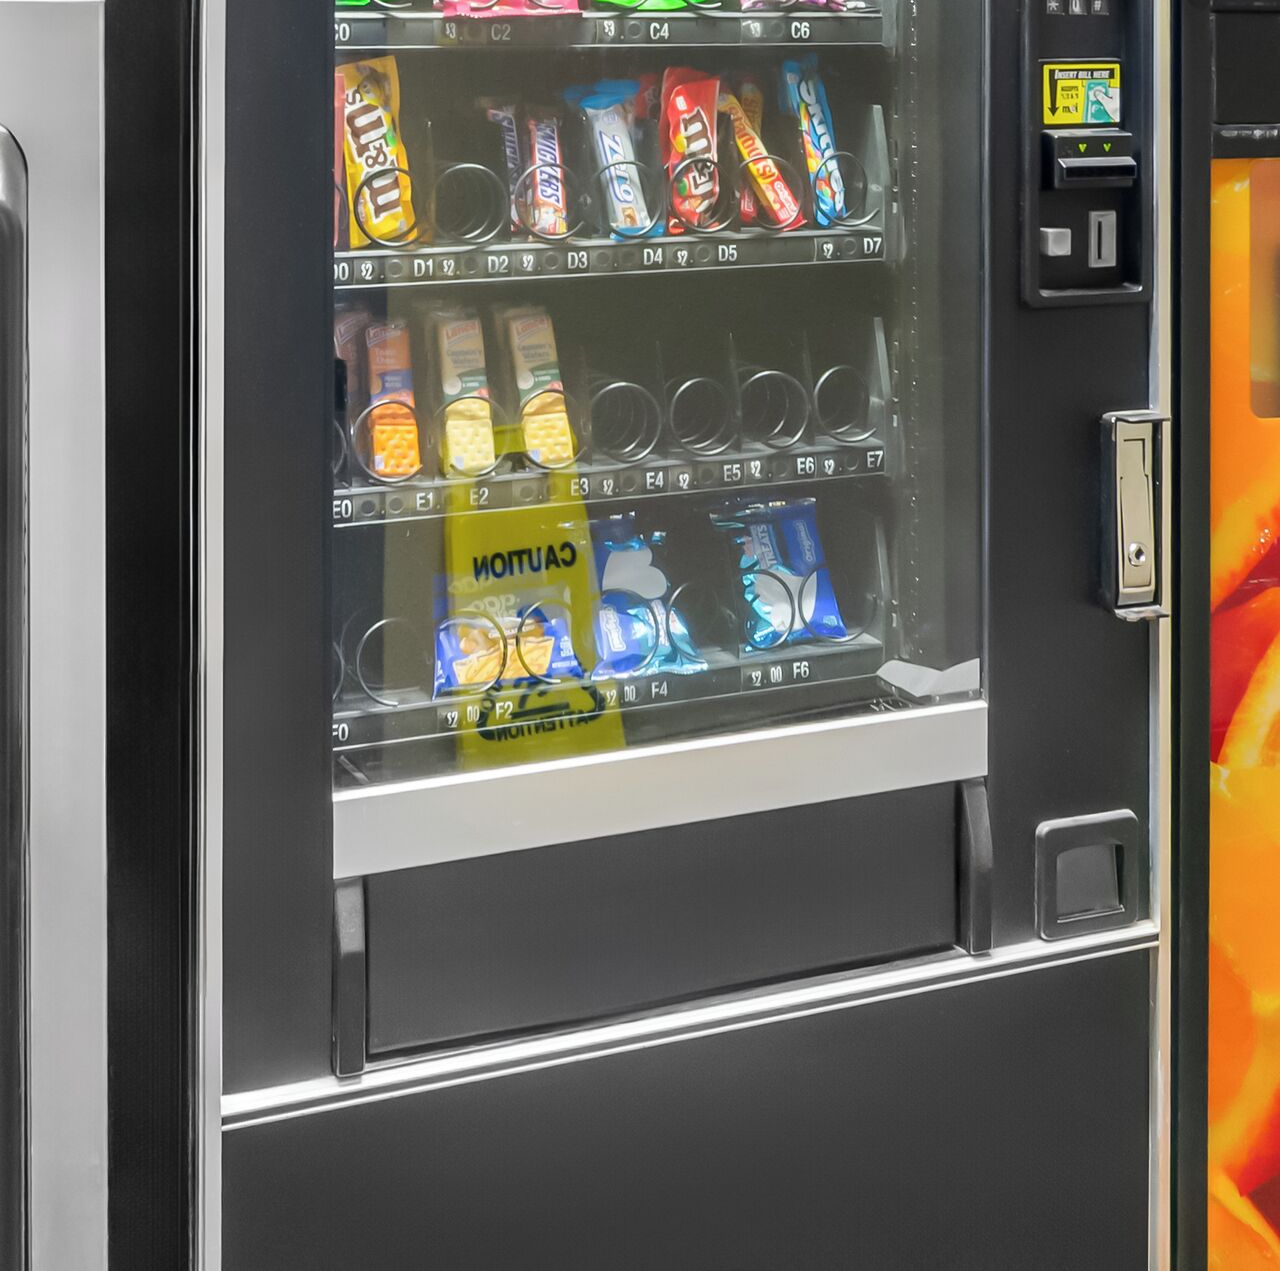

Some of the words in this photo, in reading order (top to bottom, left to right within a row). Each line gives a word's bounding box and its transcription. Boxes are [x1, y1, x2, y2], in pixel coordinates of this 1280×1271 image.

[1072, 0, 1081, 12] 0
[491, 24, 511, 41] C2
[650, 23, 669, 40] C4
[791, 21, 810, 39] C6
[535, 120, 562, 205] SNICKERS
[718, 245, 738, 262] D5
[863, 237, 882, 254] D7
[488, 256, 509, 273] D2
[568, 251, 588, 269] D3
[643, 248, 663, 265] D4
[414, 259, 434, 277] D1
[796, 457, 815, 476] E6
[866, 451, 884, 468] E7
[646, 472, 664, 490] E4
[723, 463, 741, 481] E5
[470, 487, 489, 505] E2
[571, 479, 588, 496] E3
[416, 492, 433, 511] E1
[757, 523, 779, 565] TREATS
[793, 661, 810, 679] F6
[651, 681, 668, 699] F4
[496, 701, 514, 720] F2
